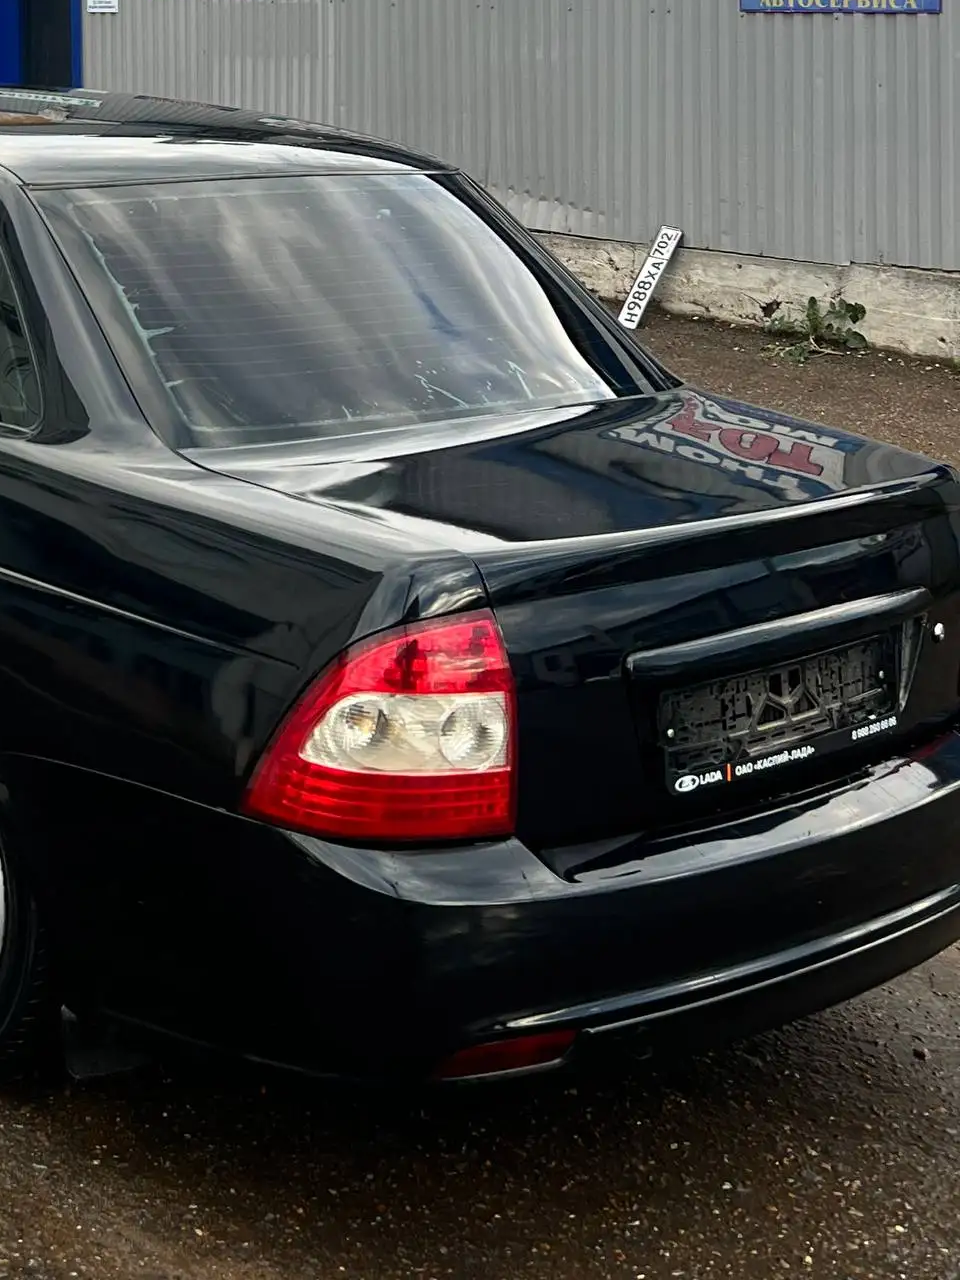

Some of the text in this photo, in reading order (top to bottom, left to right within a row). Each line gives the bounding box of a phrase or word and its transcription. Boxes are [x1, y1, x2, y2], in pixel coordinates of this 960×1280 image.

[624, 233, 674, 323] Н988ХА 702
[735, 763, 753, 776] ОАО
[700, 770, 723, 785] LADA
